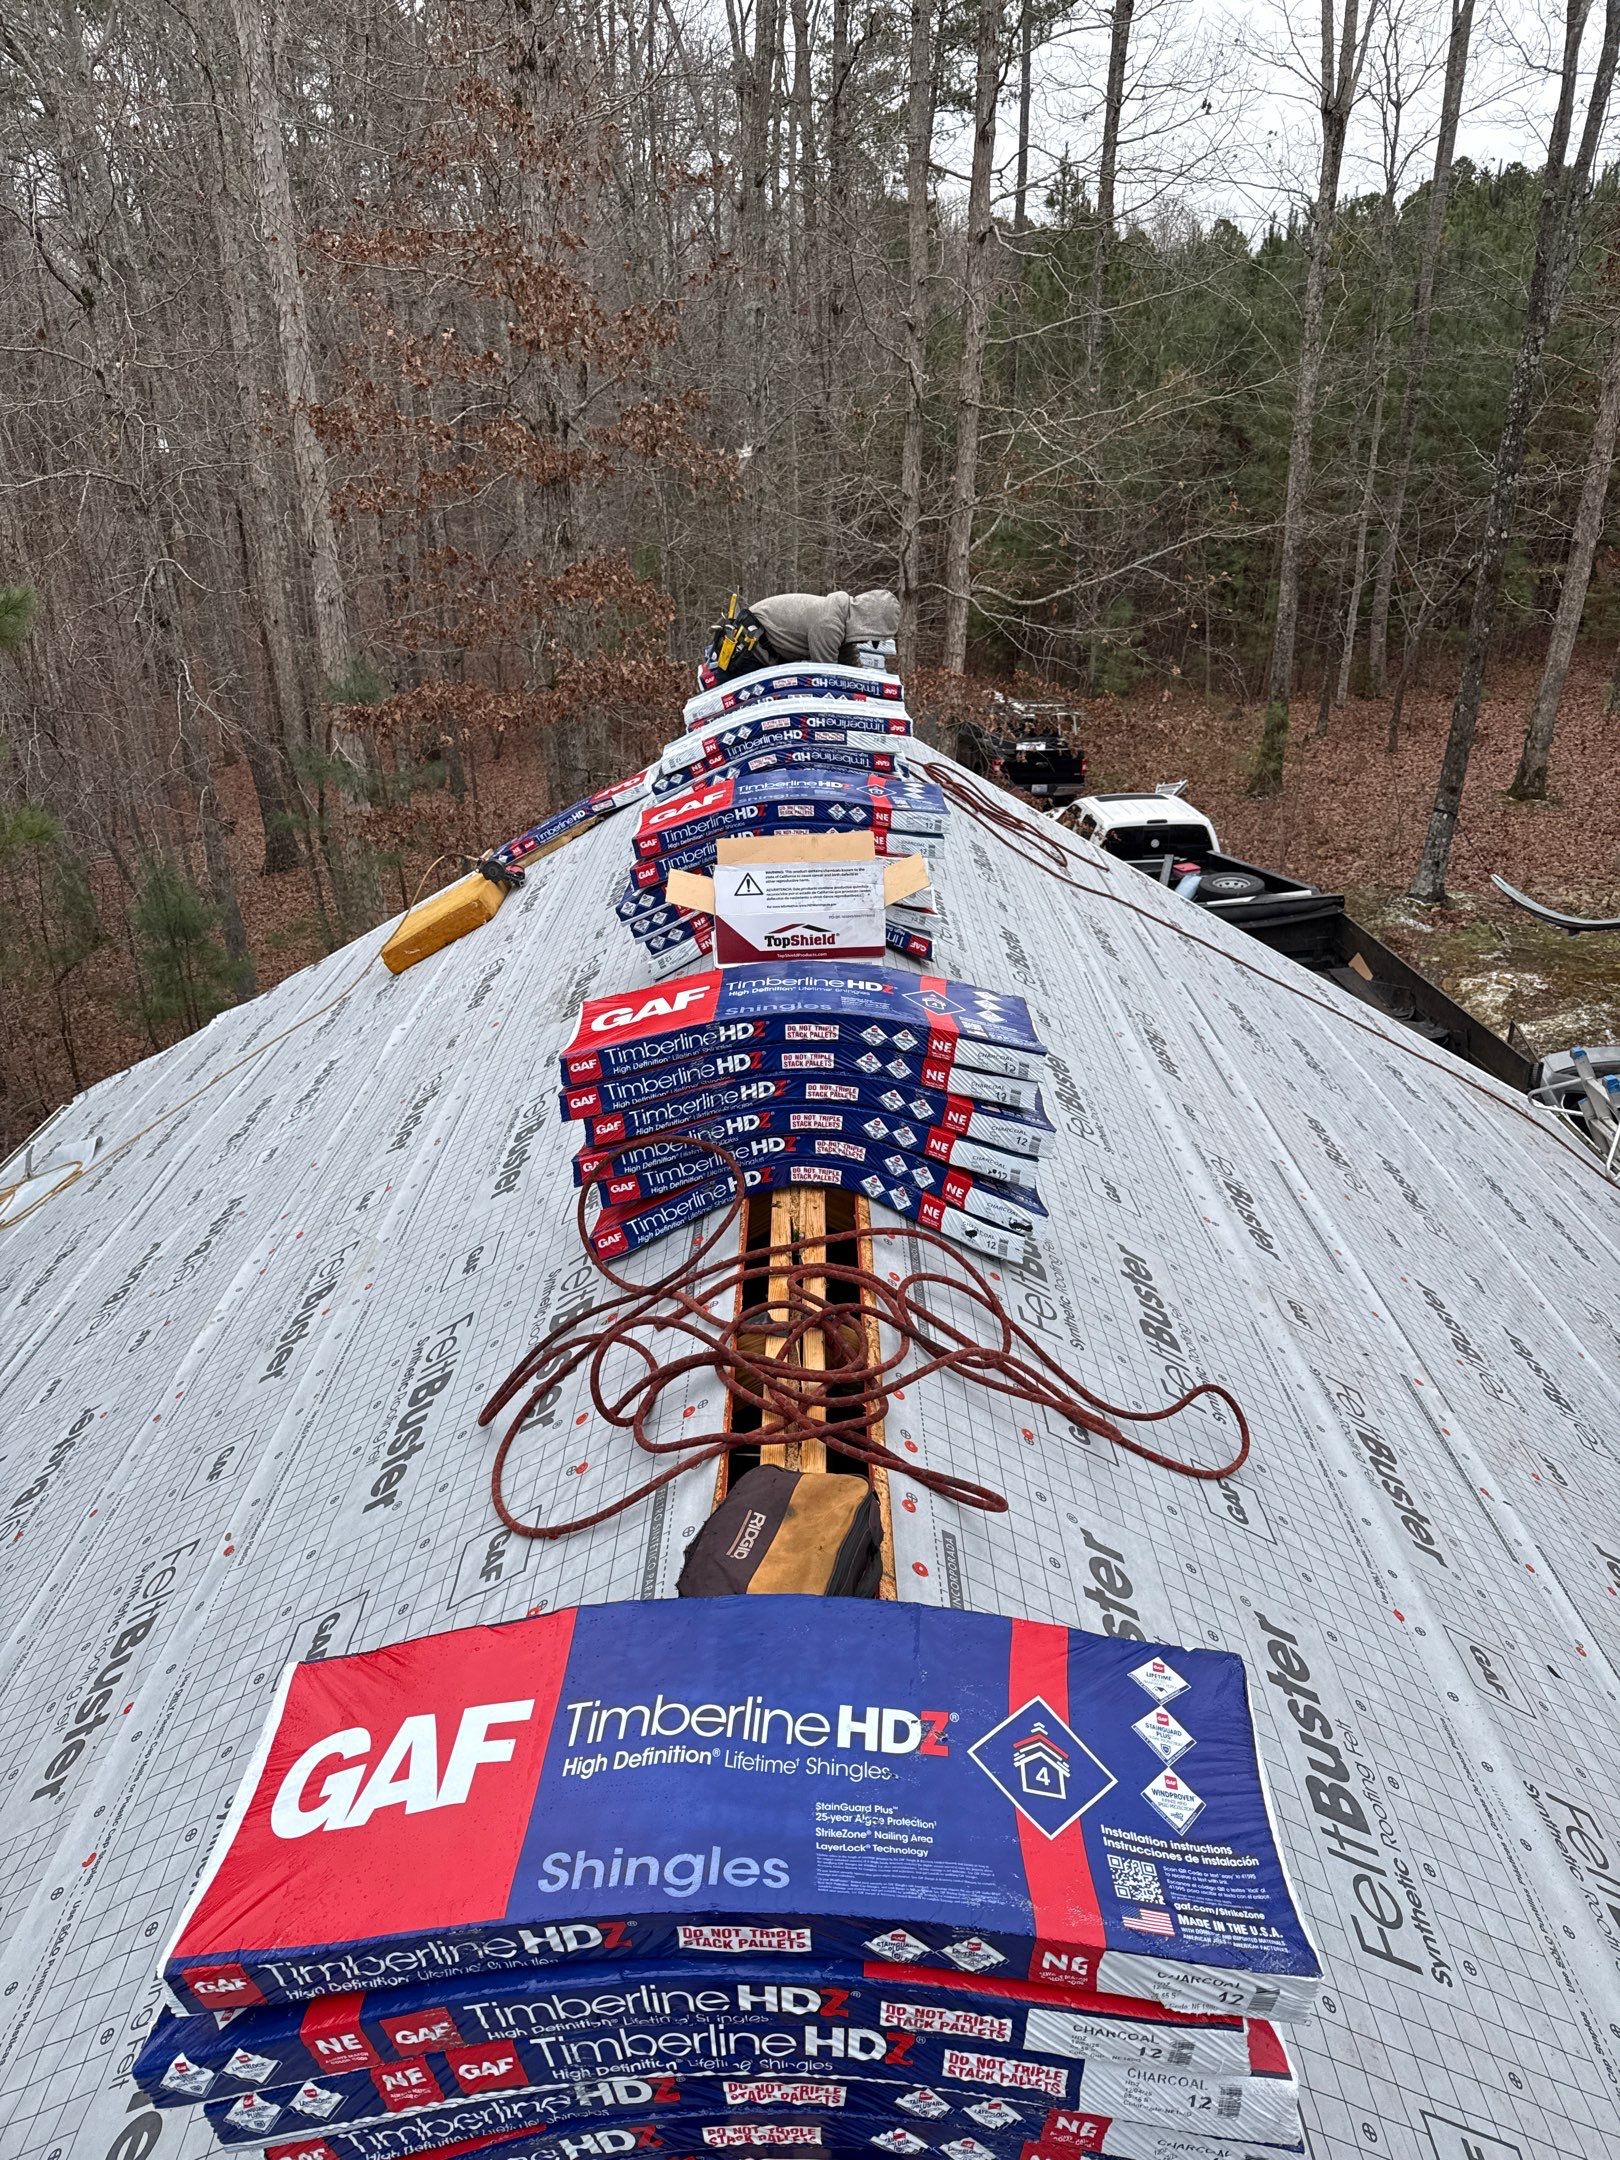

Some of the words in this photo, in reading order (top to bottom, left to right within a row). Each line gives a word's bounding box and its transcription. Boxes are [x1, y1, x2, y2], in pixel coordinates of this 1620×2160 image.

[828, 679, 880, 695] Timberline
[828, 718, 885, 733] Timberline
[709, 755, 723, 764] GAF
[726, 734, 783, 756] Timberline
[812, 751, 869, 767] Timberline
[649, 790, 726, 824] GAF
[640, 839, 658, 848] GAF
[662, 813, 734, 843] Timberline
[727, 977, 845, 990] Timberline
[591, 986, 710, 1031] GAF
[571, 1059, 597, 1072] GAF
[604, 1030, 718, 1065] Timberline
[932, 1040, 952, 1051] NE
[613, 1064, 630, 1075] High
[926, 1070, 945, 1082] NE
[1003, 1063, 1016, 1074] 12
[571, 1094, 597, 1108] GAF
[604, 1064, 715, 1100] Timberline
[596, 1120, 622, 1134] GAF
[629, 1086, 738, 1126] Timberline
[612, 1099, 631, 1109] High
[1044, 1053, 1099, 1147] FeltBuster
[636, 1125, 653, 1135] High
[948, 1113, 967, 1125] NE
[991, 1125, 1027, 1135] CHARCOAL
[491, 1086, 557, 1200] FeltBuster
[930, 1139, 949, 1151] NE
[1016, 1137, 1028, 1146] 12
[624, 1163, 641, 1173] High
[610, 1181, 636, 1193] GAF
[947, 1183, 964, 1195] NE
[598, 1233, 622, 1248] GAF
[627, 1183, 726, 1235] Timberline
[923, 1205, 940, 1218] NE
[1204, 1149, 1282, 1262] FeltBuster
[986, 1240, 996, 1249] 12
[258, 1240, 360, 1384] FeltBuster
[1116, 1241, 1207, 1414] FeltBuster
[1414, 1278, 1515, 1408] FeltBuster
[398, 1335, 430, 1393] Synthetic
[1501, 1325, 1611, 1460] FeltBuster
[373, 1391, 408, 1443] Roofing
[364, 1442, 387, 1468] Felt
[1326, 1374, 1449, 1569] FeltBuster
[733, 1512, 766, 1560] RIDGID
[107, 1560, 156, 1634] Synthetic
[65, 1634, 116, 1701] Roofing
[51, 1700, 78, 1736] Felt
[156, 1711, 174, 1739] Plastic
[567, 1694, 831, 1748] Timberline
[1335, 1718, 1361, 1757] Felt
[271, 1698, 535, 1840] GAF
[562, 1755, 608, 1780] High
[805, 1757, 892, 1783] Shingles
[1034, 1766, 1051, 1786] 4
[1254, 1610, 1424, 1976] FeltBuster
[1355, 1759, 1402, 1853] Roofing
[113, 1794, 133, 1826] Plastic
[816, 1802, 872, 1813] StainGuard
[816, 1813, 852, 1824] 25-year
[102, 1825, 117, 1849] Cap
[874, 1831, 909, 1844] Nailing
[911, 1834, 933, 1843] Area
[1101, 1824, 1167, 1848] Installation
[1170, 1840, 1233, 1855] instructions
[1523, 1780, 1585, 1883] Synthetic
[873, 1844, 929, 1857] Technology
[1103, 1837, 1182, 1863] Instrucciones
[1185, 1852, 1199, 1864] de
[1202, 1855, 1259, 1867] instalación
[537, 1845, 790, 1898] Shingles
[67, 1900, 82, 1923] Use
[1174, 1902, 1265, 1920] gaf.com/StrikeZone
[1391, 1856, 1455, 1988] Synthetic
[1526, 1892, 1547, 1933] Puntillas
[682, 1927, 705, 1939] DO
[708, 1928, 742, 1939] NOT
[1177, 1914, 1211, 1929] MADE
[1213, 1920, 1225, 1932] IN
[1226, 1923, 1248, 1935] THE
[1249, 1926, 1284, 1938] U.S.A.
[738, 1939, 807, 1950] PALLETS
[258, 1933, 517, 1989] Timberline
[26, 1956, 56, 2011] Puntillas
[1218, 1992, 1245, 2006] 12
[395, 2022, 452, 2046] GAF
[463, 1984, 731, 2029] Timberline
[912, 2008, 945, 2022] NOT
[315, 2033, 364, 2055] NE
[487, 2027, 527, 2041] High
[1073, 2023, 1161, 2045] CHARCOAL
[108, 2035, 146, 2090] Felt
[458, 2056, 515, 2080] GAF
[529, 2024, 797, 2068] Timberline
[381, 2067, 428, 2091] NE
[552, 2067, 590, 2081] High
[947, 2064, 994, 2080] STACK
[948, 2052, 967, 2066] DO
[973, 2057, 1005, 2073] NOT
[1012, 2063, 1064, 2081] TRIPLE
[1127, 2067, 1209, 2091] CHARCOAL
[1188, 2094, 1212, 2110] 12
[1055, 2116, 1100, 2138] NE
